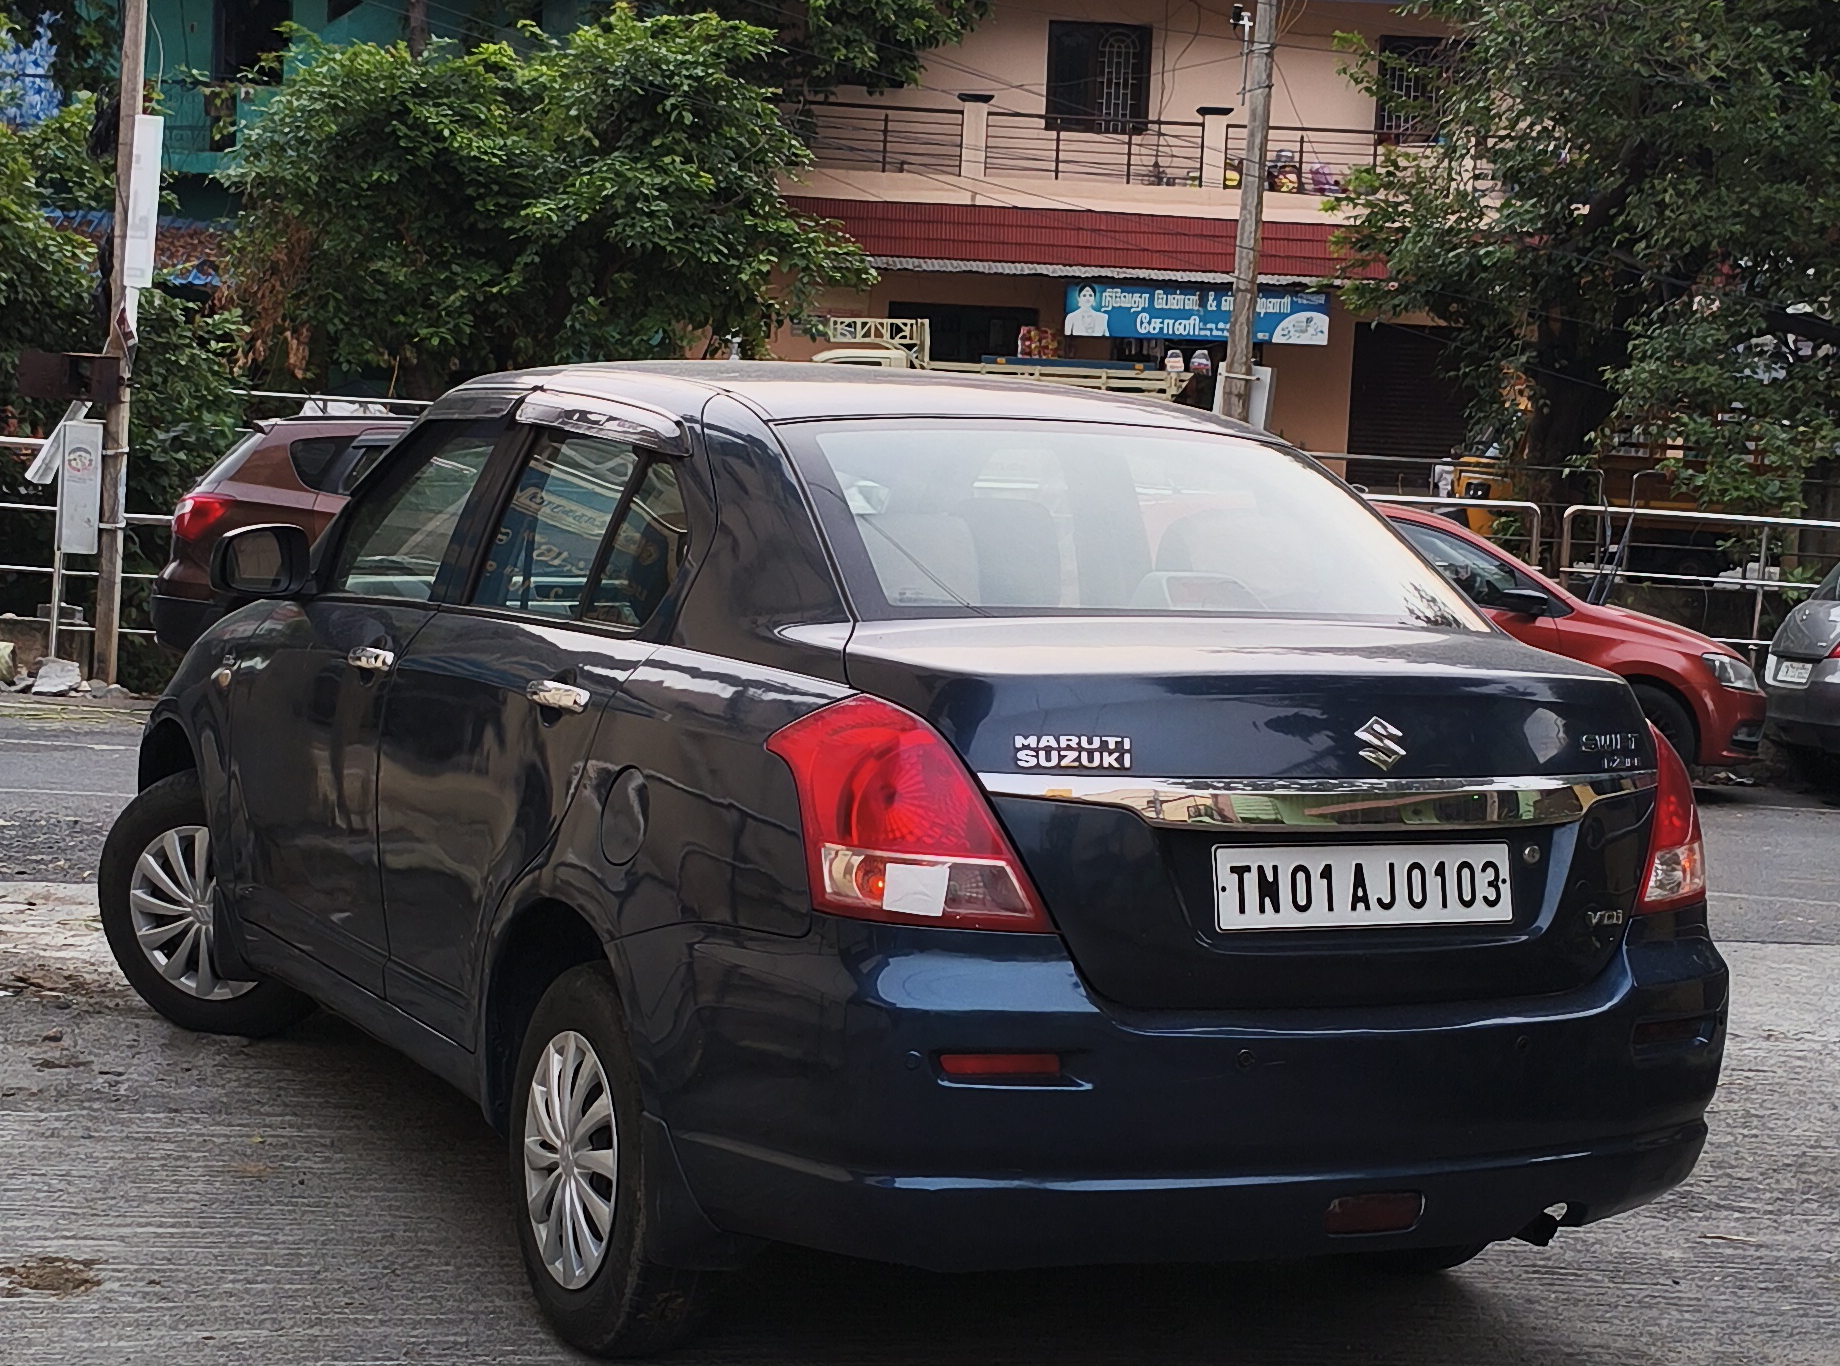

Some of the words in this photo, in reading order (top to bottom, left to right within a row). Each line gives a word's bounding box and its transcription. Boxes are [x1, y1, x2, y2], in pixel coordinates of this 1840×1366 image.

[1101, 288, 1150, 313] நிவேதா
[1207, 291, 1217, 311] &
[1014, 735, 1131, 750] MARUTI
[1016, 749, 1131, 768] SUZUKI
[1229, 860, 1502, 915] TN01AJ0103
